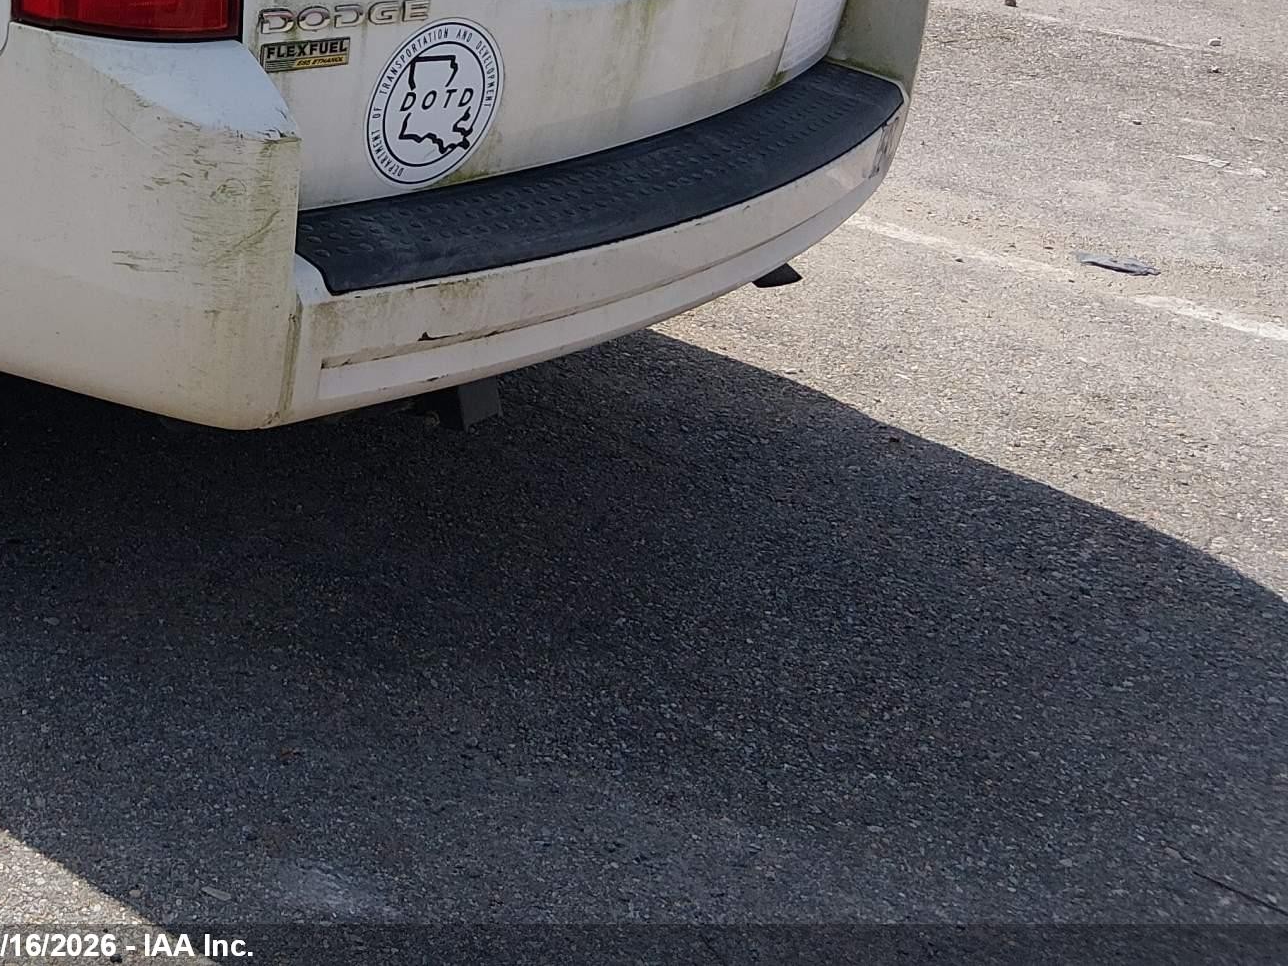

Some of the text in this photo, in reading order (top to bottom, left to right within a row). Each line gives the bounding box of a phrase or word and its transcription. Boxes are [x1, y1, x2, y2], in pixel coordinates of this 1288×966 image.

[266, 40, 348, 59] FLEXFUEL
[371, 26, 496, 177] DEPARTMENT OF TRANSPORTATION AND DEVELOPMENT
[399, 87, 474, 112] DOTD
